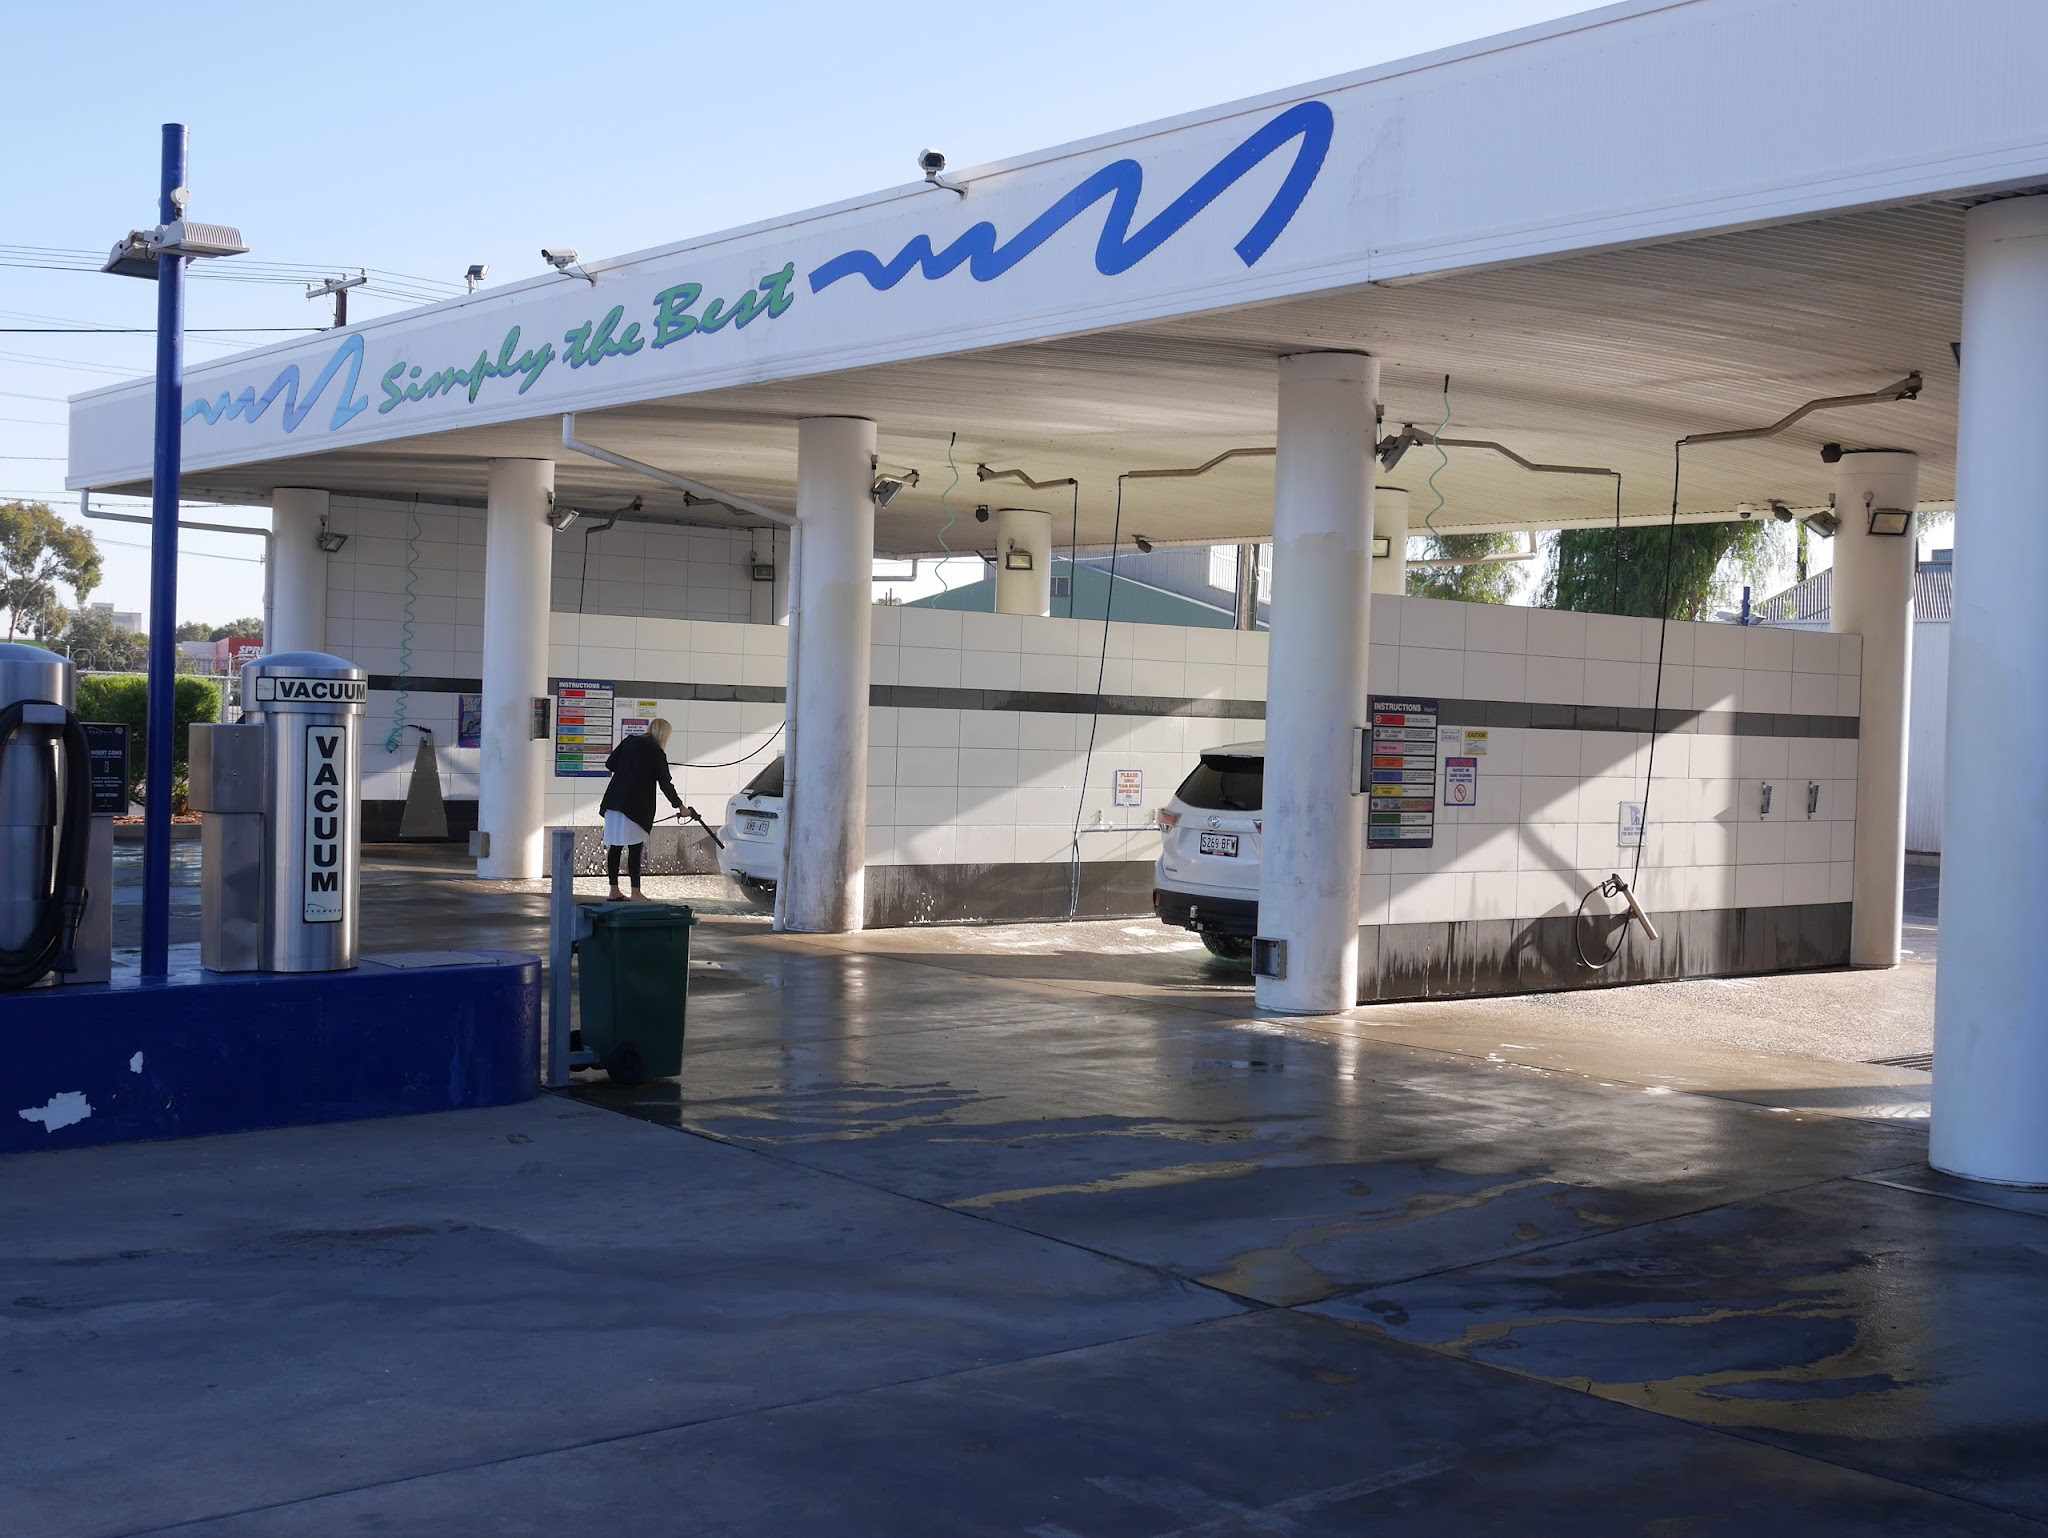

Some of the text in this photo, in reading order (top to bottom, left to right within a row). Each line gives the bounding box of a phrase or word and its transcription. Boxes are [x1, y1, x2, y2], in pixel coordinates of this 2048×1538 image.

[378, 262, 796, 414] Simply the Best
[280, 681, 367, 700] VACUUM
[1374, 702, 1422, 712] INSTRUCTIONS
[311, 736, 339, 892] VACUUM
